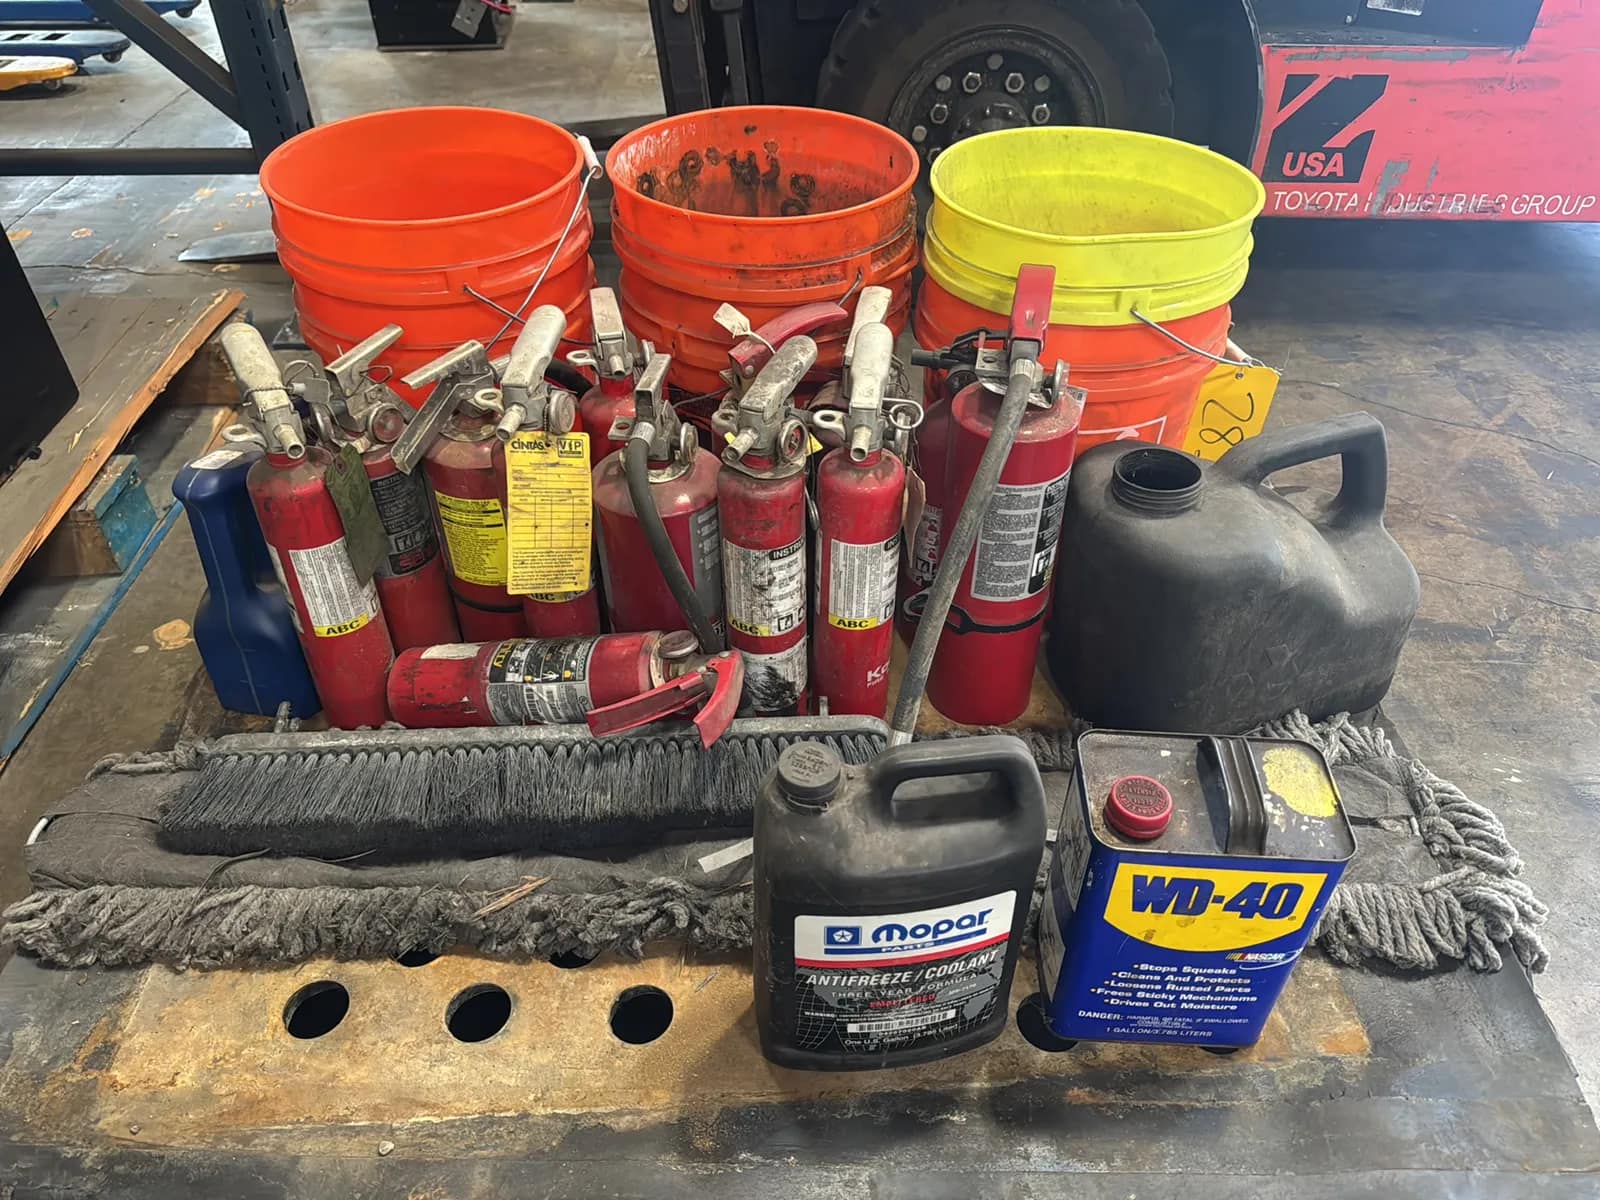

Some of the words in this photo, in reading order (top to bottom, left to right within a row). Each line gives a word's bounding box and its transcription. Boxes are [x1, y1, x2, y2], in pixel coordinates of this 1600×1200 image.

[1281, 151, 1344, 177] USA
[1273, 190, 1359, 212] TOYOTA
[1511, 193, 1597, 216] GROUP
[326, 619, 361, 636] ABC
[732, 618, 759, 635] ABC
[837, 618, 869, 629] ABC
[1132, 874, 1304, 920] WD-40
[871, 908, 993, 944] Mopar
[881, 940, 936, 953] PARTS
[1245, 952, 1286, 962] NASCAR
[1138, 963, 1178, 974] Stops
[1182, 966, 1237, 976] Squeaks
[1117, 971, 1161, 981] Cleans
[1164, 975, 1191, 983] And
[1193, 976, 1251, 985] Protects
[831, 990, 873, 999] THREE
[880, 987, 913, 997] YEAR
[1110, 980, 1162, 991] Loosens
[1165, 983, 1211, 993] Rusted
[1214, 985, 1252, 993] Parts
[1096, 988, 1133, 998] Frees
[1136, 991, 1176, 1001] Sticky
[1179, 994, 1258, 1003] Mechanisms
[1109, 998, 1150, 1008] Drives
[1153, 1001, 1177, 1009] Out
[1180, 1003, 1239, 1011] Moisture
[1077, 1010, 1124, 1021] DANGER:
[1179, 1030, 1213, 1038] LITERS
